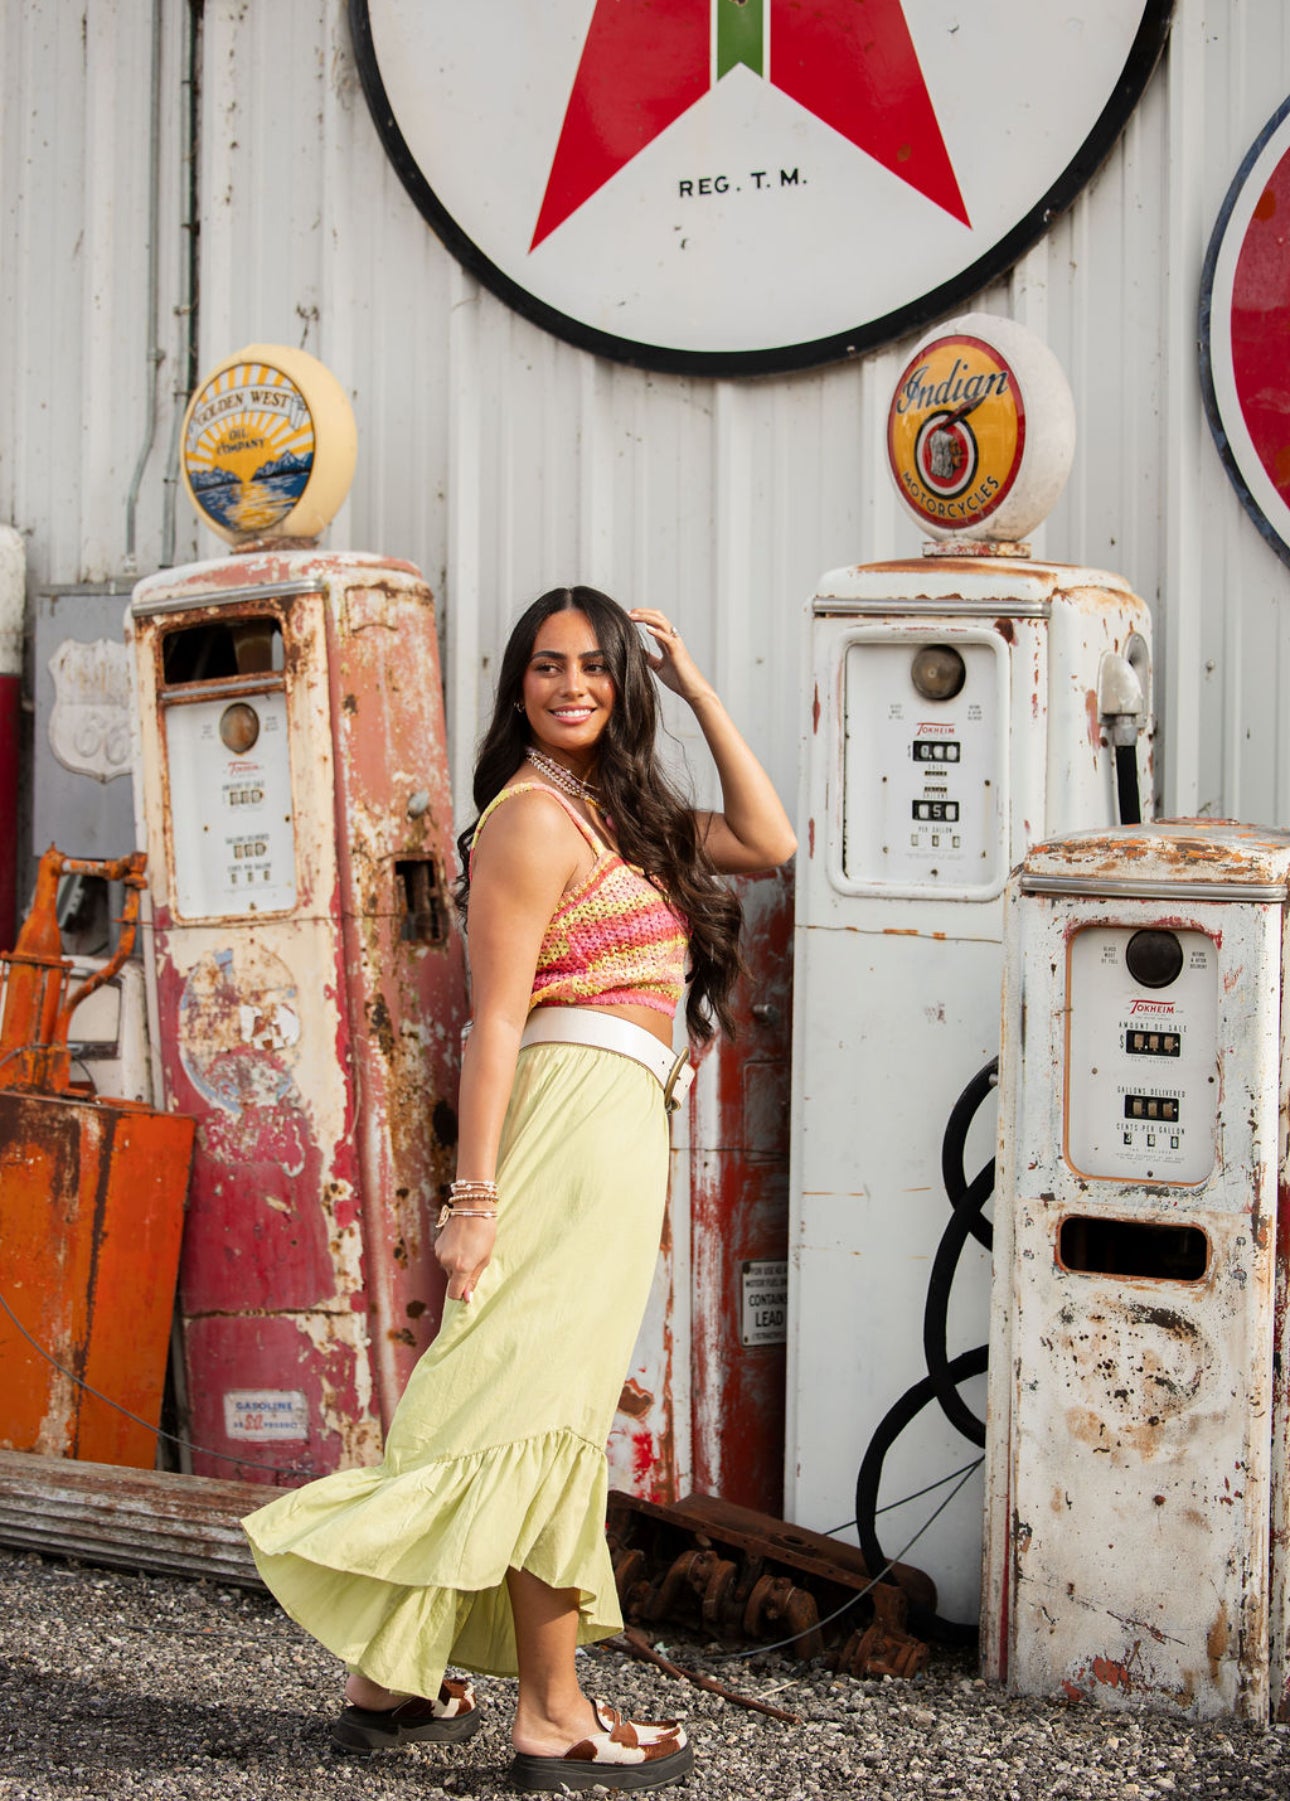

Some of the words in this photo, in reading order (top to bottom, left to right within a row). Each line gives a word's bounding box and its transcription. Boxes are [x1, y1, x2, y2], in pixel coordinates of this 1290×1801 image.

[679, 176, 741, 198] REG.
[896, 359, 1009, 415] Indian
[195, 392, 244, 426] GOLDEN
[250, 390, 291, 409] WEST
[228, 428, 248, 441] OIL
[216, 438, 265, 456] COMPANY
[902, 471, 1000, 519] MOTORCYCLES
[1130, 999, 1176, 1015] TOKHEIM
[1118, 1021, 1149, 1030] AMOUNT
[1154, 1023, 1163, 1031] OF
[1168, 1024, 1188, 1033] SALE
[1117, 1085, 1146, 1096] GALLONS
[1151, 1088, 1186, 1099] DELIVERED
[1116, 1122, 1138, 1132] CENTS
[1142, 1124, 1155, 1133] PER
[1159, 1126, 1185, 1136] GALLON
[755, 1310, 784, 1328] LEAD
[235, 1402, 292, 1411] GASOLINE
